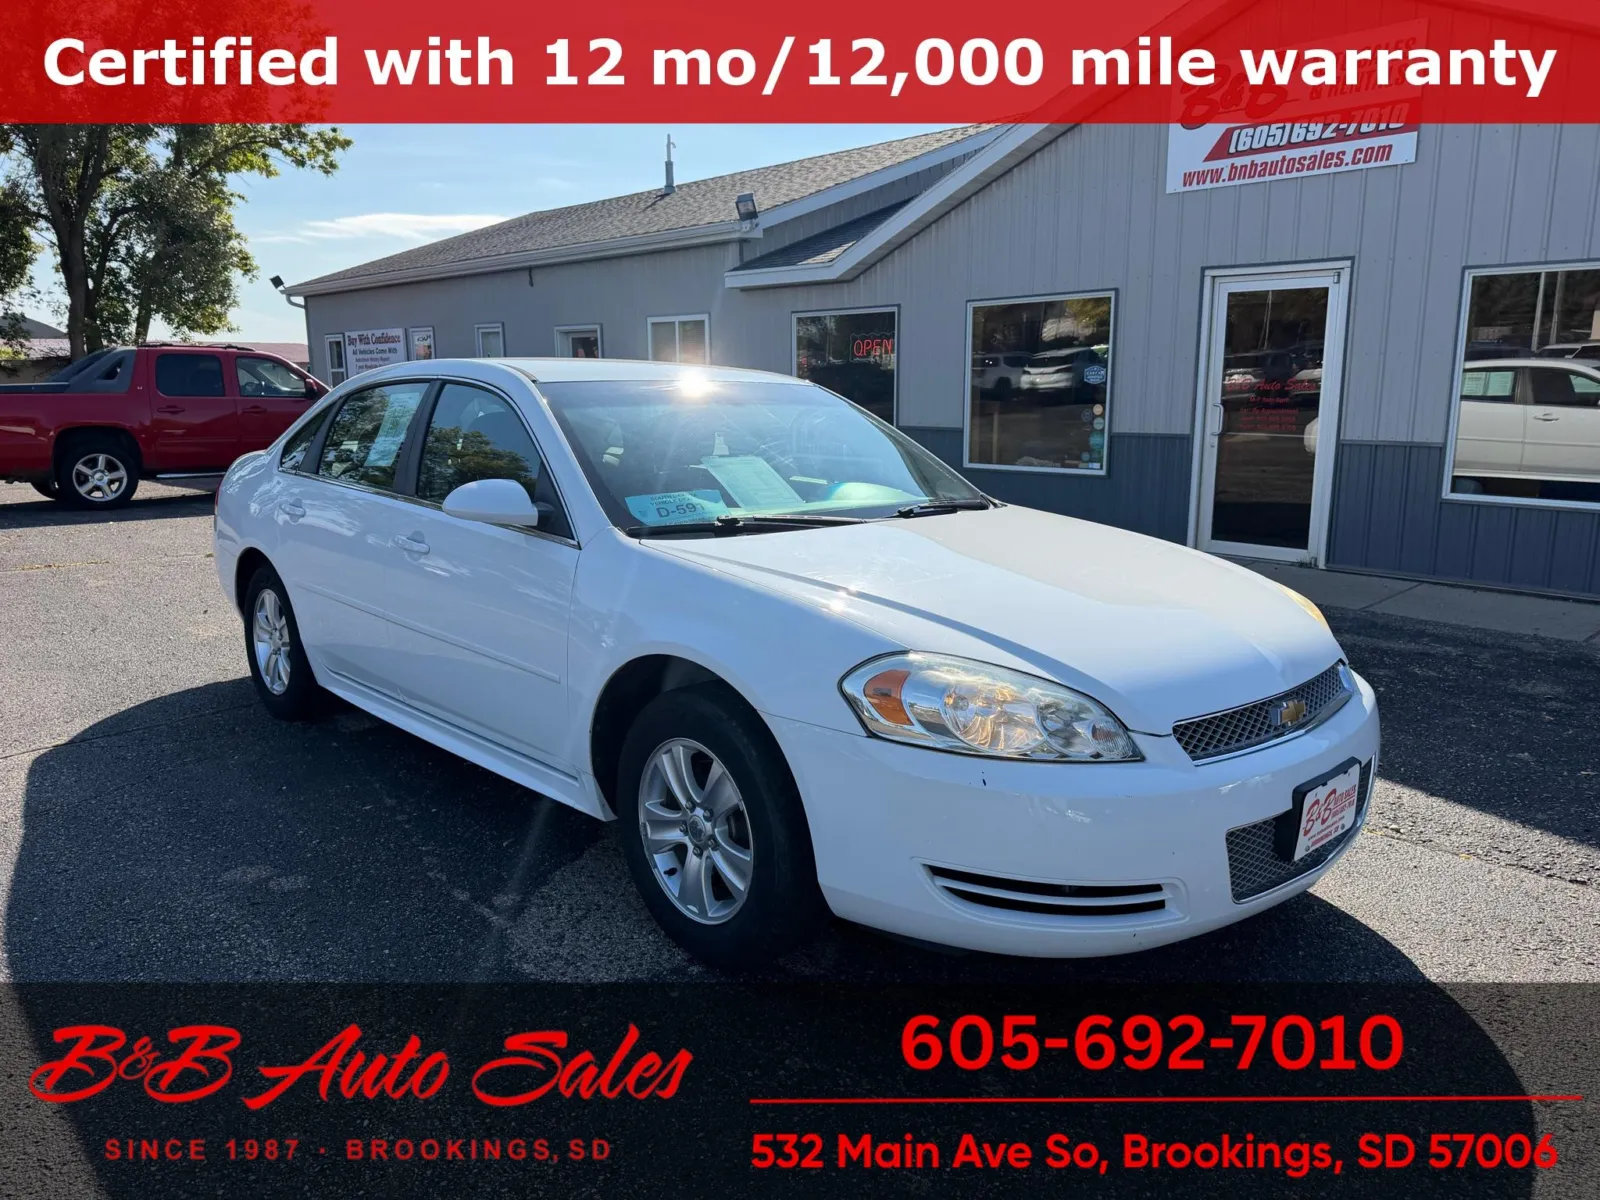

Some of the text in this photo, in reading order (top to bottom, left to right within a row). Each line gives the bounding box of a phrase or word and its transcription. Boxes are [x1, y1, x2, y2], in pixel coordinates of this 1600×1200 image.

[1182, 143, 1394, 188] www.bnbautosales.com
[347, 335, 358, 348] Buy
[358, 333, 371, 346] With
[371, 332, 401, 345] Confidence
[853, 338, 893, 357] OPEN
[1254, 378, 1282, 391] Auto
[1284, 376, 1317, 392] Sales
